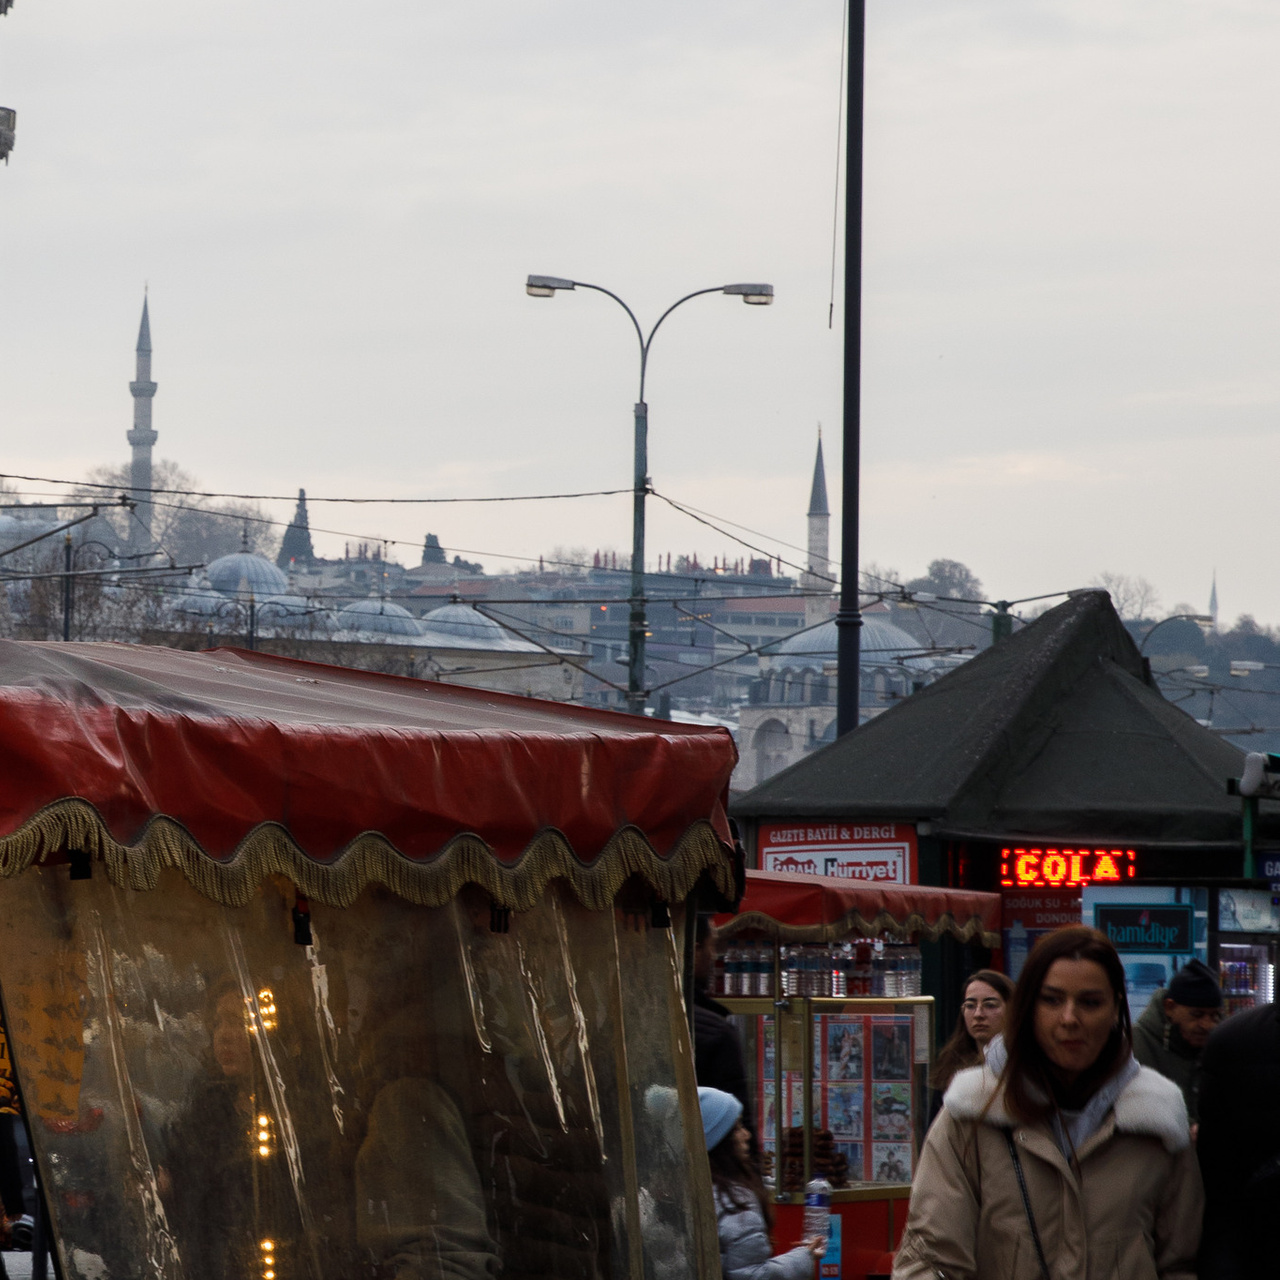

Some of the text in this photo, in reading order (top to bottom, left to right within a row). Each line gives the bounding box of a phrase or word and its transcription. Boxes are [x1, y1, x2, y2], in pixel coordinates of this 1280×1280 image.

[770, 829, 805, 843] GAZETE
[840, 827, 851, 839] &
[853, 823, 896, 839] DERGİ
[826, 860, 896, 881] Hürriyet
[1016, 854, 1121, 882] COLA
[1004, 896, 1043, 909] SOĞUK
[1044, 898, 1061, 908] SU
[1107, 918, 1179, 950] hamidiye
